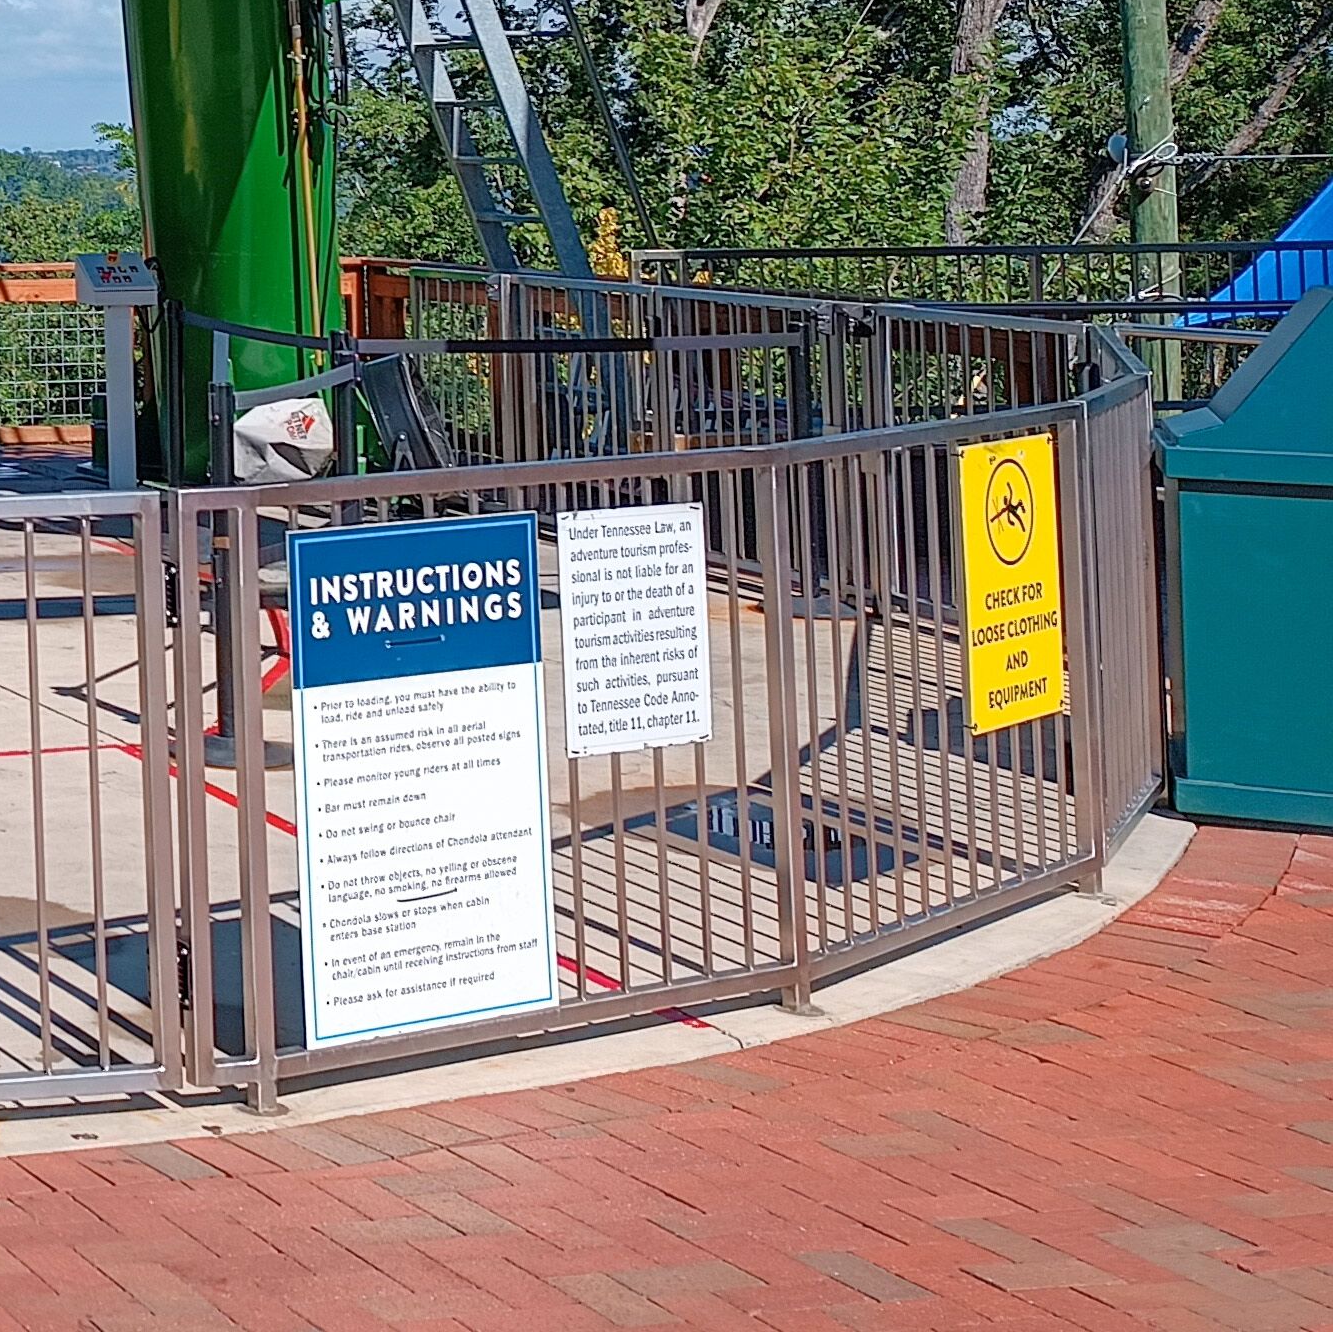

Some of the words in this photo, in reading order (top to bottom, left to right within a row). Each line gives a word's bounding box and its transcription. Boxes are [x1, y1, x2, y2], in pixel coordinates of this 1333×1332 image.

[568, 526, 598, 541] Under
[600, 524, 651, 538] Tennessee
[678, 520, 692, 532] an
[570, 548, 618, 562] adventure
[620, 543, 657, 558] tourism
[658, 539, 692, 557] profes-
[309, 557, 521, 606] INSTRUCTIONS
[571, 569, 601, 584] sional
[603, 567, 613, 581] is
[615, 566, 633, 579] not
[634, 563, 662, 578] liable
[664, 561, 679, 575] for
[681, 563, 694, 574] an
[571, 591, 599, 607] injury
[601, 590, 612, 603] to
[614, 590, 625, 602] or
[626, 587, 643, 601] the
[645, 584, 673, 599] death
[675, 581, 685, 596] of
[687, 584, 694, 595] a
[985, 586, 1020, 611] CHECK
[1022, 582, 1044, 601] FOR
[310, 610, 331, 640] &
[346, 591, 522, 636] WARNINGS
[573, 610, 626, 629] participant
[632, 608, 642, 621] in
[648, 605, 695, 620] adventure
[574, 633, 611, 649] tourism
[612, 629, 655, 645] activities
[655, 625, 697, 641] resulting
[972, 623, 1005, 648] LOOSE
[1007, 610, 1059, 638] CLOTHING
[575, 657, 598, 671] from
[601, 654, 617, 668] the
[620, 650, 660, 665] inherent
[662, 647, 685, 661] risks
[687, 645, 698, 659] of
[1005, 649, 1029, 673] AND
[576, 677, 600, 693] such
[656, 667, 699, 686] pursuant
[577, 701, 588, 715] to
[590, 697, 641, 712] Tennessee
[643, 692, 668, 707] Code
[671, 690, 699, 703] Anno-
[988, 676, 1048, 710] EQUIPMENT
[608, 718, 628, 733] title
[646, 713, 683, 728] chapter
